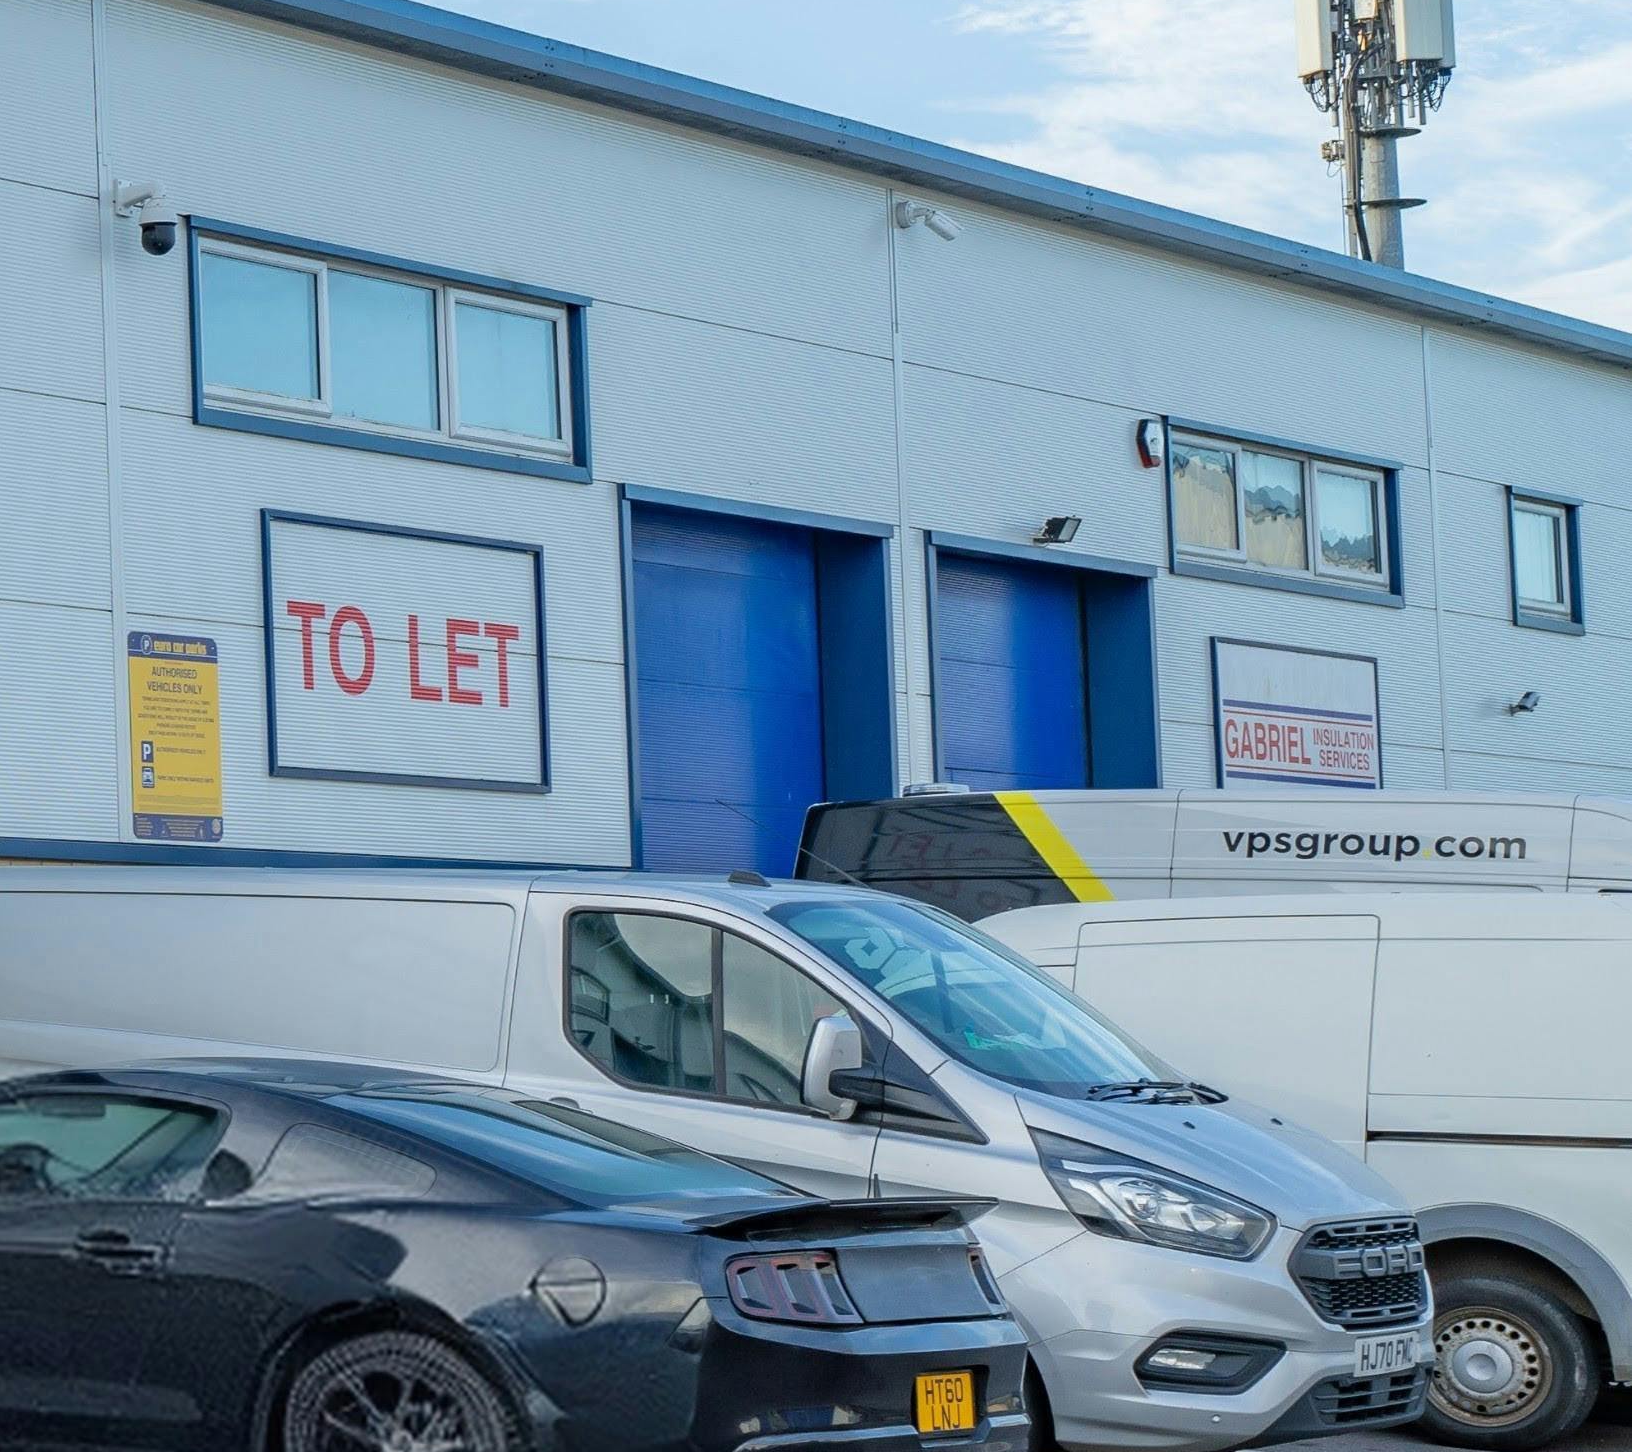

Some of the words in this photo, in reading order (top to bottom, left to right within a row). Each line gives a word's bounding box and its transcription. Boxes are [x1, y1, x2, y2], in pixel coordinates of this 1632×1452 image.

[287, 600, 375, 696] TO
[408, 614, 520, 708] LET
[151, 666, 198, 680] AUTHORISED
[146, 680, 182, 694] VEHICLES
[183, 683, 204, 695] ONLY
[1225, 718, 1312, 765] GABRIEL
[1312, 728, 1375, 751] INSULATION
[1319, 749, 1371, 771] SERVICES
[1222, 830, 1527, 862] vpsgroup.com
[1334, 1241, 1425, 1280] FORD
[1360, 1341, 1394, 1372] HJ70
[925, 1378, 964, 1405] HT60
[931, 1403, 961, 1431] LNJ
